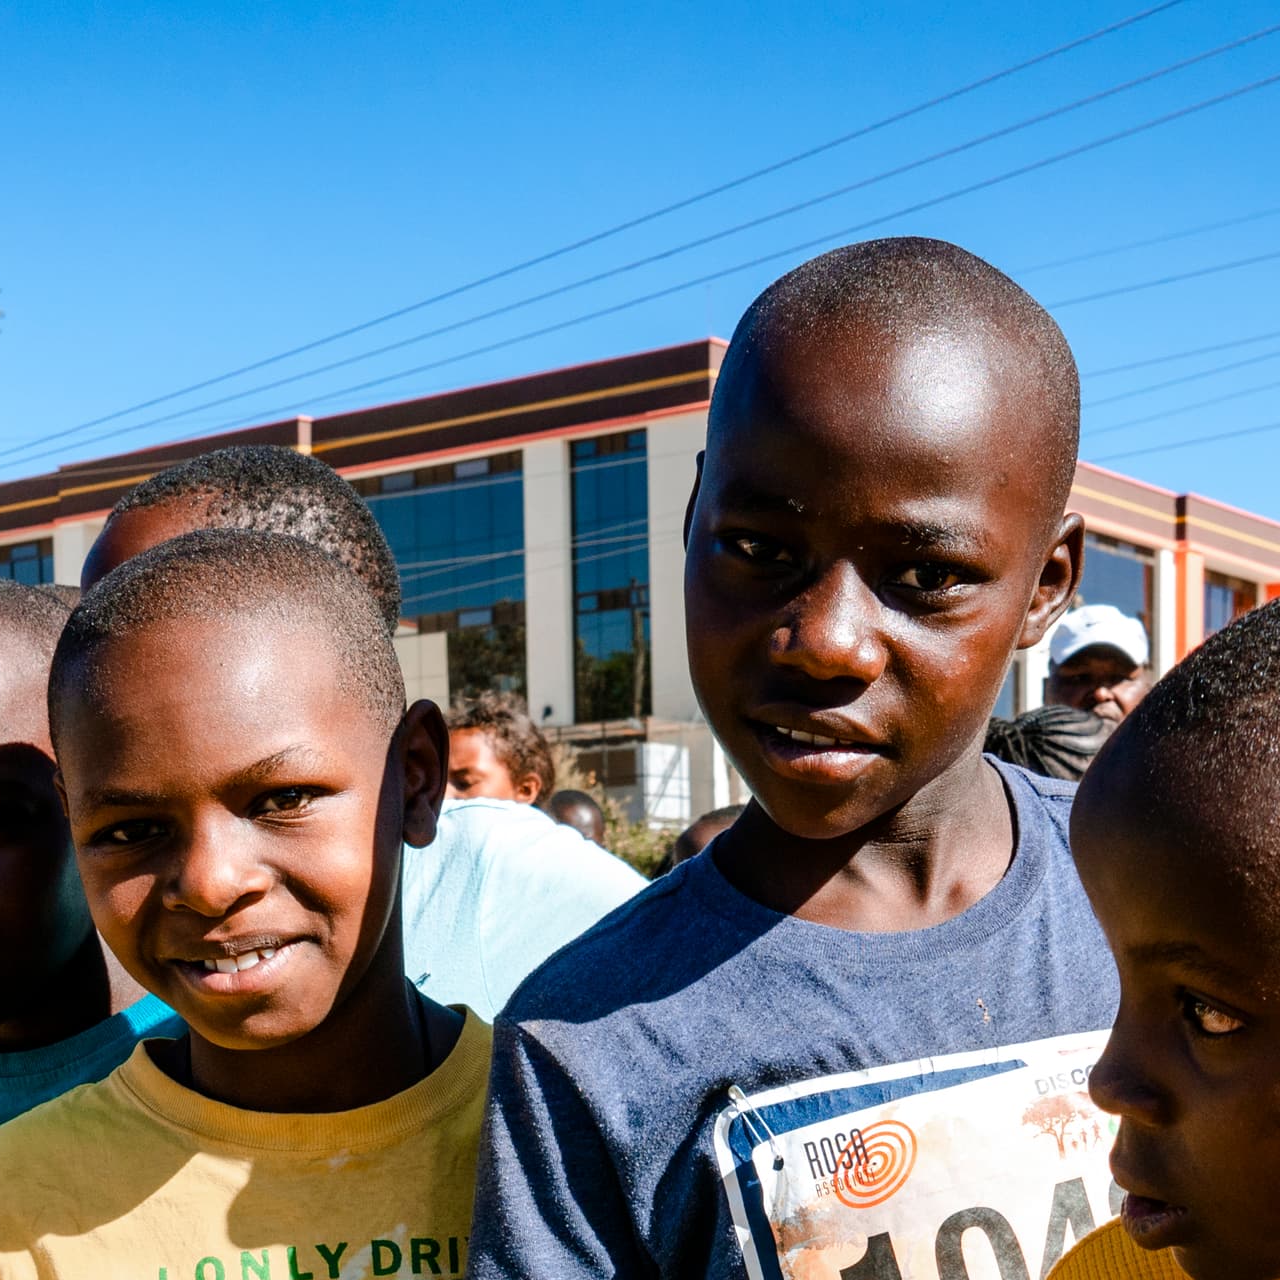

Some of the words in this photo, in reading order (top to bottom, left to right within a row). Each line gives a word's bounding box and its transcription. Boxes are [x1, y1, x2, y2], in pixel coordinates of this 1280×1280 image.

[803, 1128, 869, 1179] ROSA
[815, 1168, 876, 1198] ASSOCIATI
[371, 1236, 469, 1277] DRI
